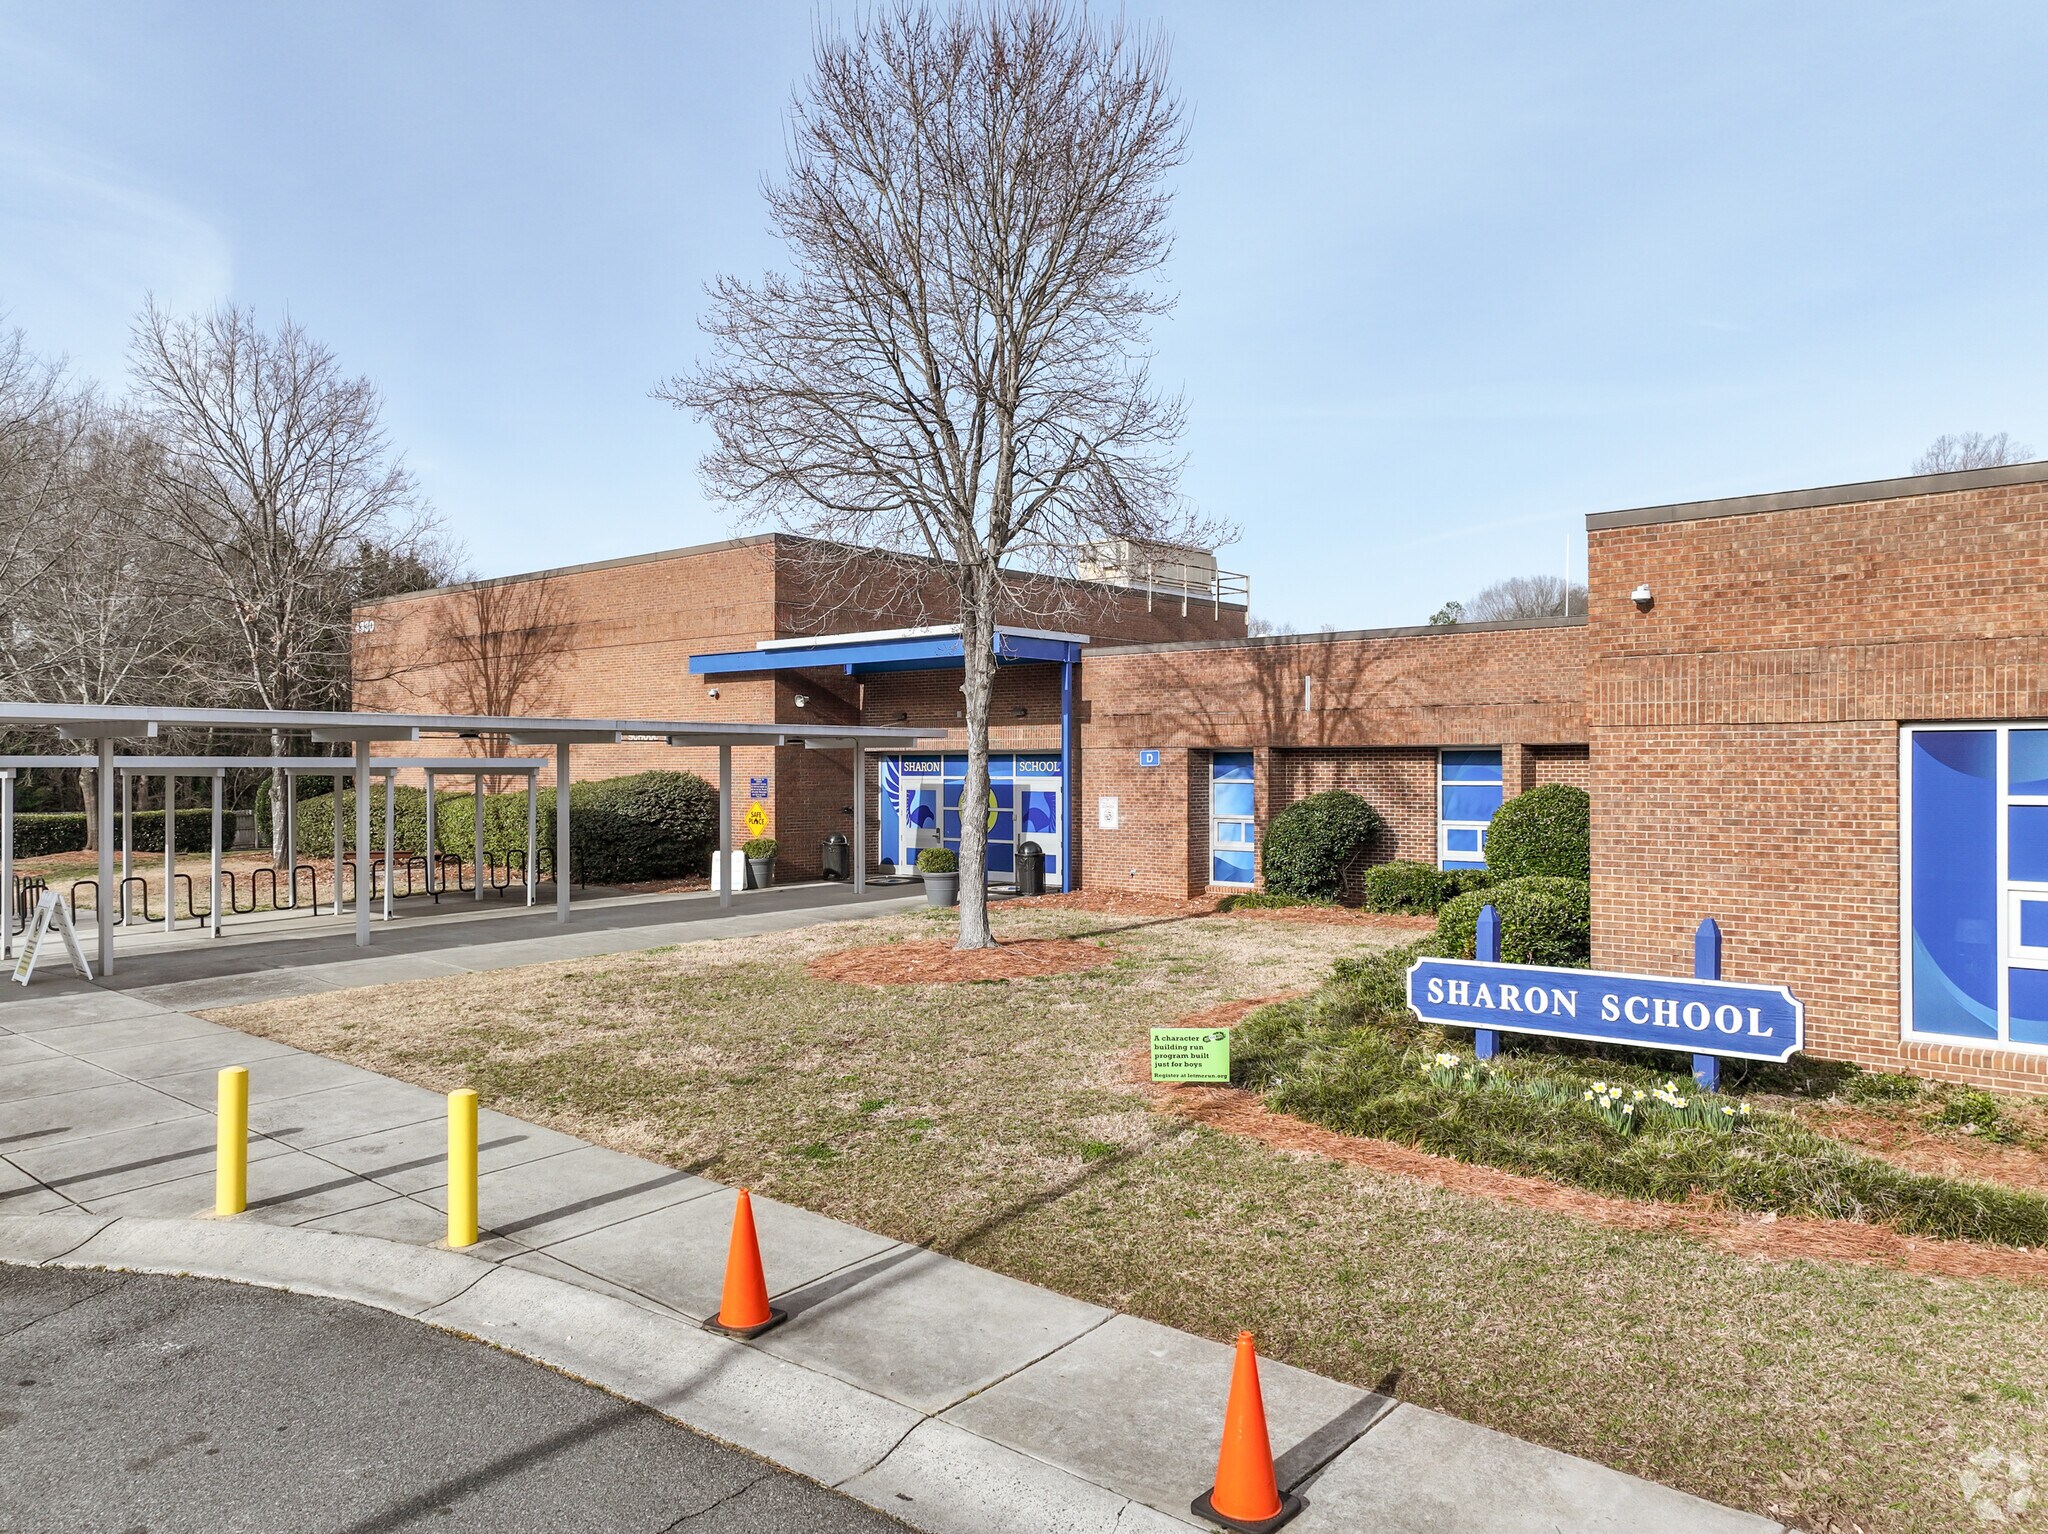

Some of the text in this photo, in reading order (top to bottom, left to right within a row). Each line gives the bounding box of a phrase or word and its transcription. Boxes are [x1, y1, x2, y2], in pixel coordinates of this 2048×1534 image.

[1146, 753, 1153, 763] D
[903, 761, 1060, 772] SHARON SCHOOL
[1427, 977, 1773, 1037] SHARON SCHOOL
